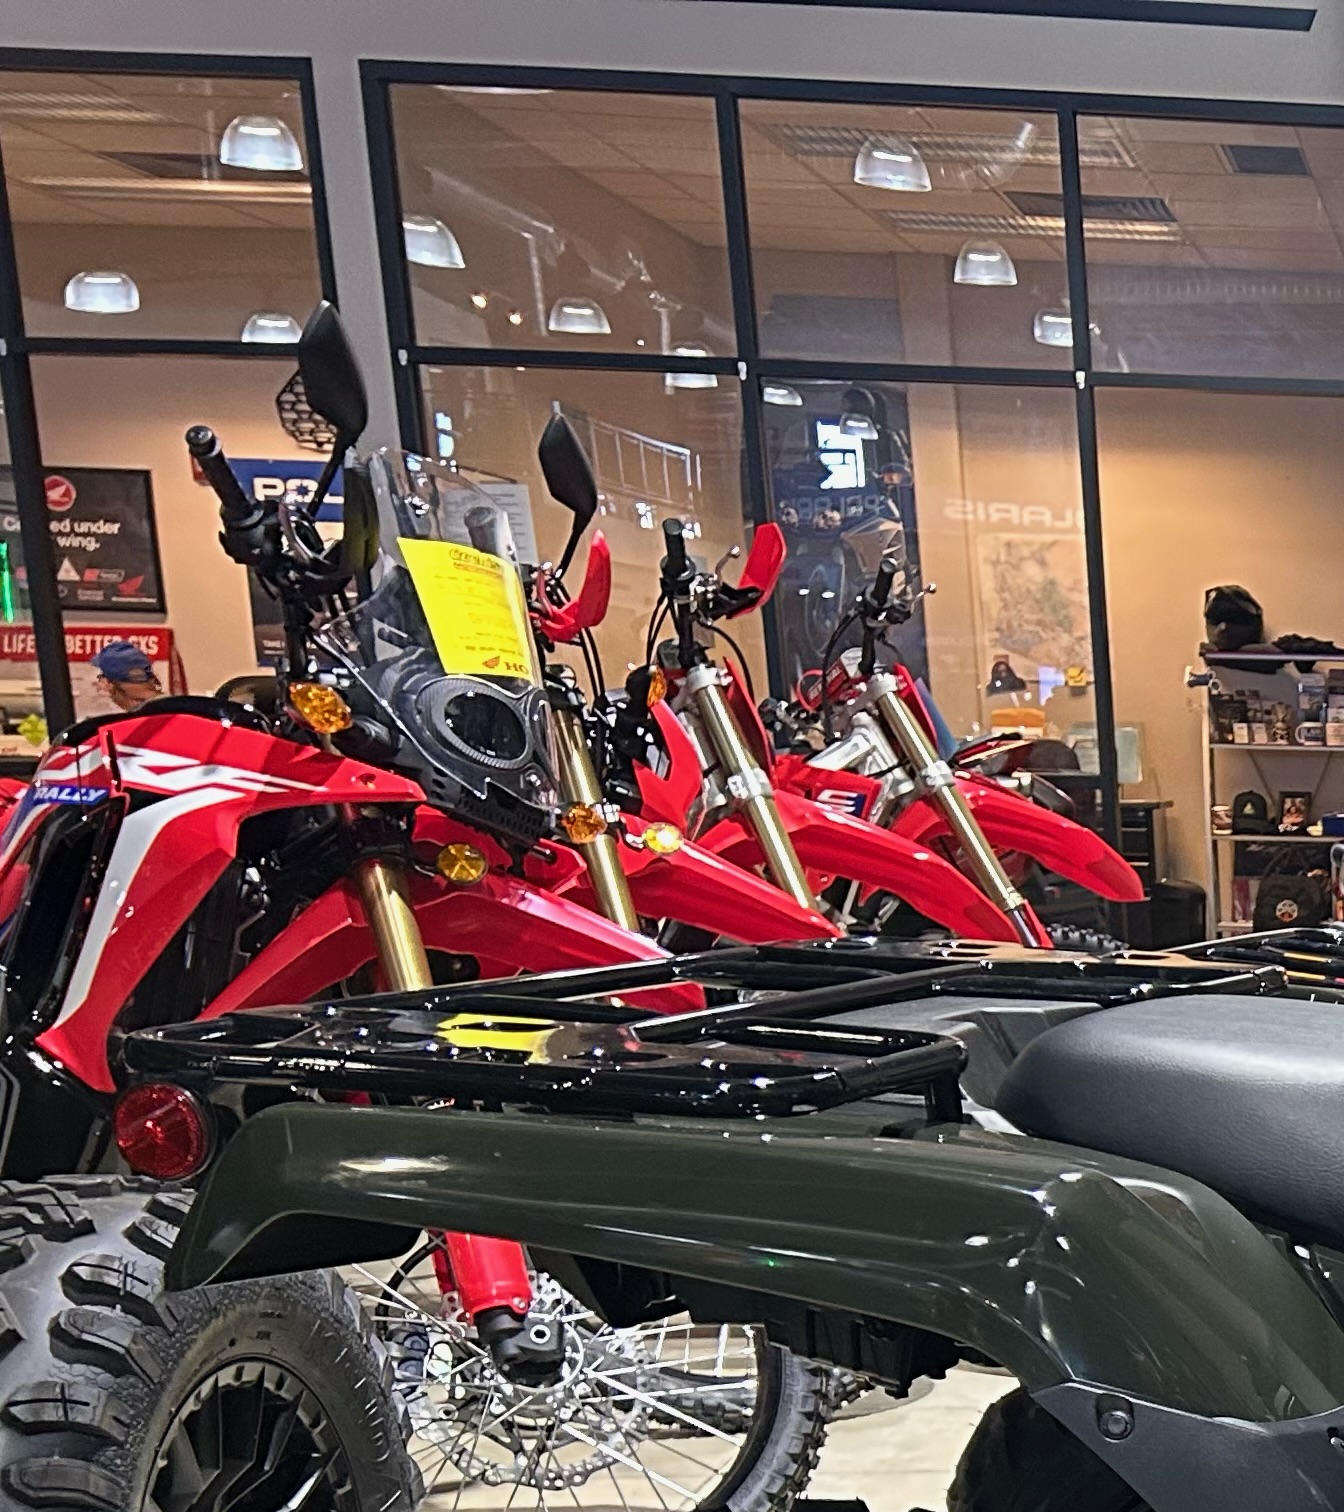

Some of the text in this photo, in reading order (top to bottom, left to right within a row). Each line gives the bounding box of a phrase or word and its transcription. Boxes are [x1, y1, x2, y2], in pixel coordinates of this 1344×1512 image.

[73, 519, 121, 535] under
[57, 535, 101, 552] wing.
[2, 634, 35, 654] LIFE
[33, 786, 107, 802] RALLY
